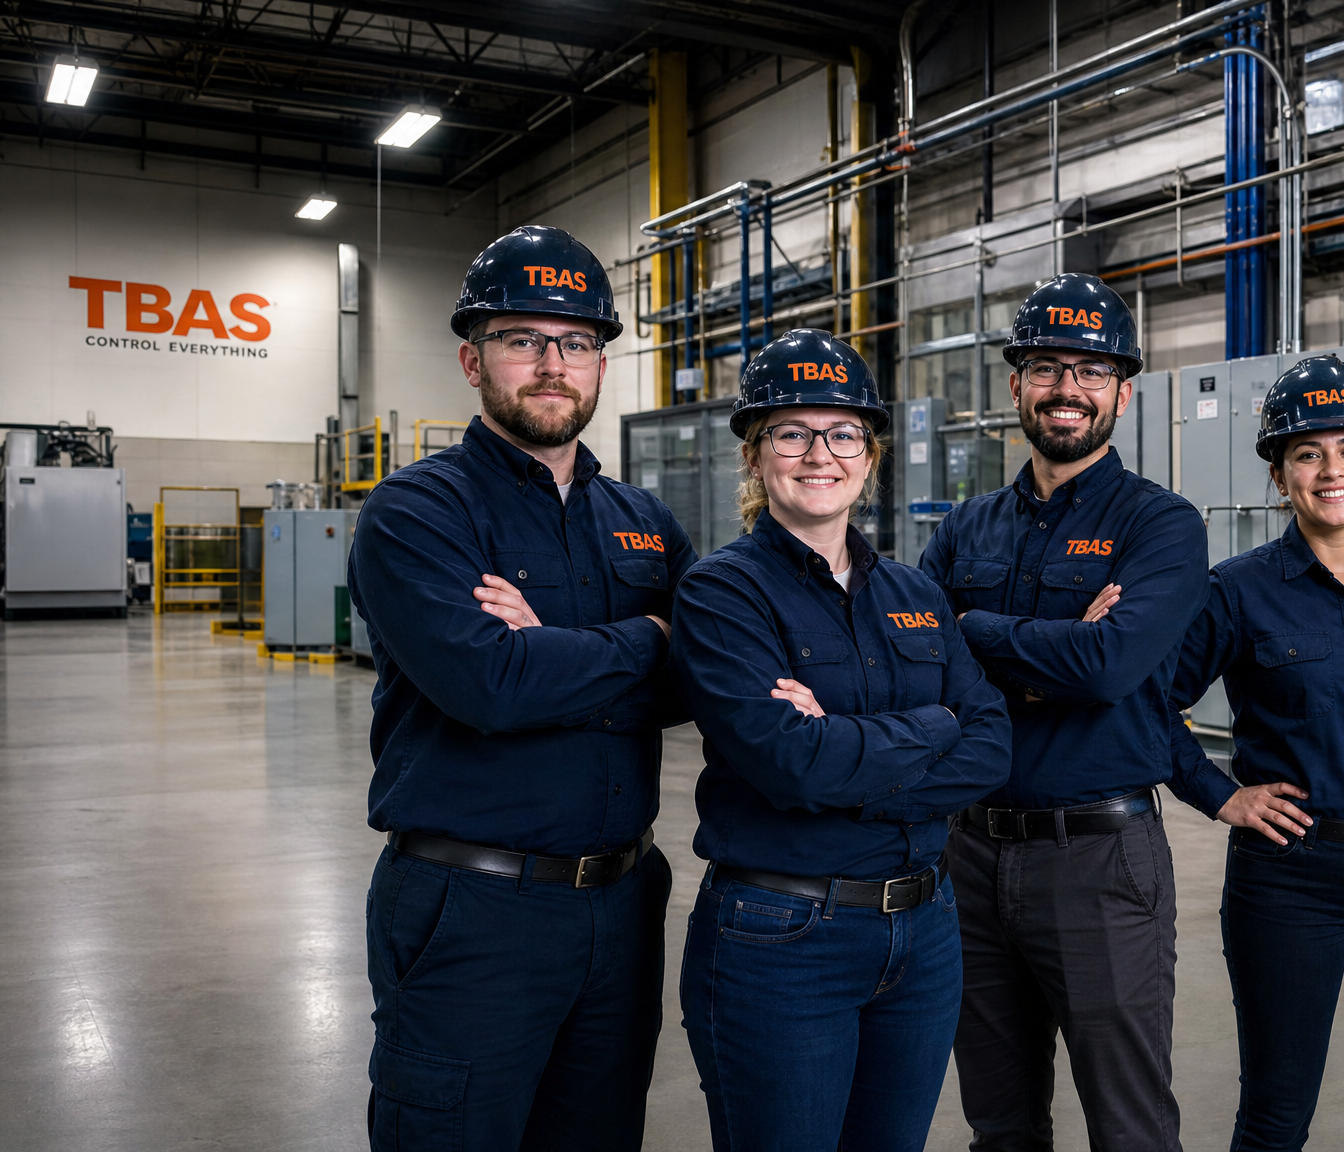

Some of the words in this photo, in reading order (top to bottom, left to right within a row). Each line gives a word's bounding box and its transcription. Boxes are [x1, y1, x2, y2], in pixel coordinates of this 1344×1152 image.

[523, 265, 588, 293] TBAS
[68, 275, 272, 342] TBAS
[1046, 306, 1103, 330] TBAS
[85, 335, 161, 351] CONTROL
[169, 342, 268, 359] EVERYTHING
[787, 362, 849, 384] TBAS
[612, 531, 665, 553] TBAS
[1065, 539, 1114, 556] TBAS
[886, 611, 939, 629] TBAS
